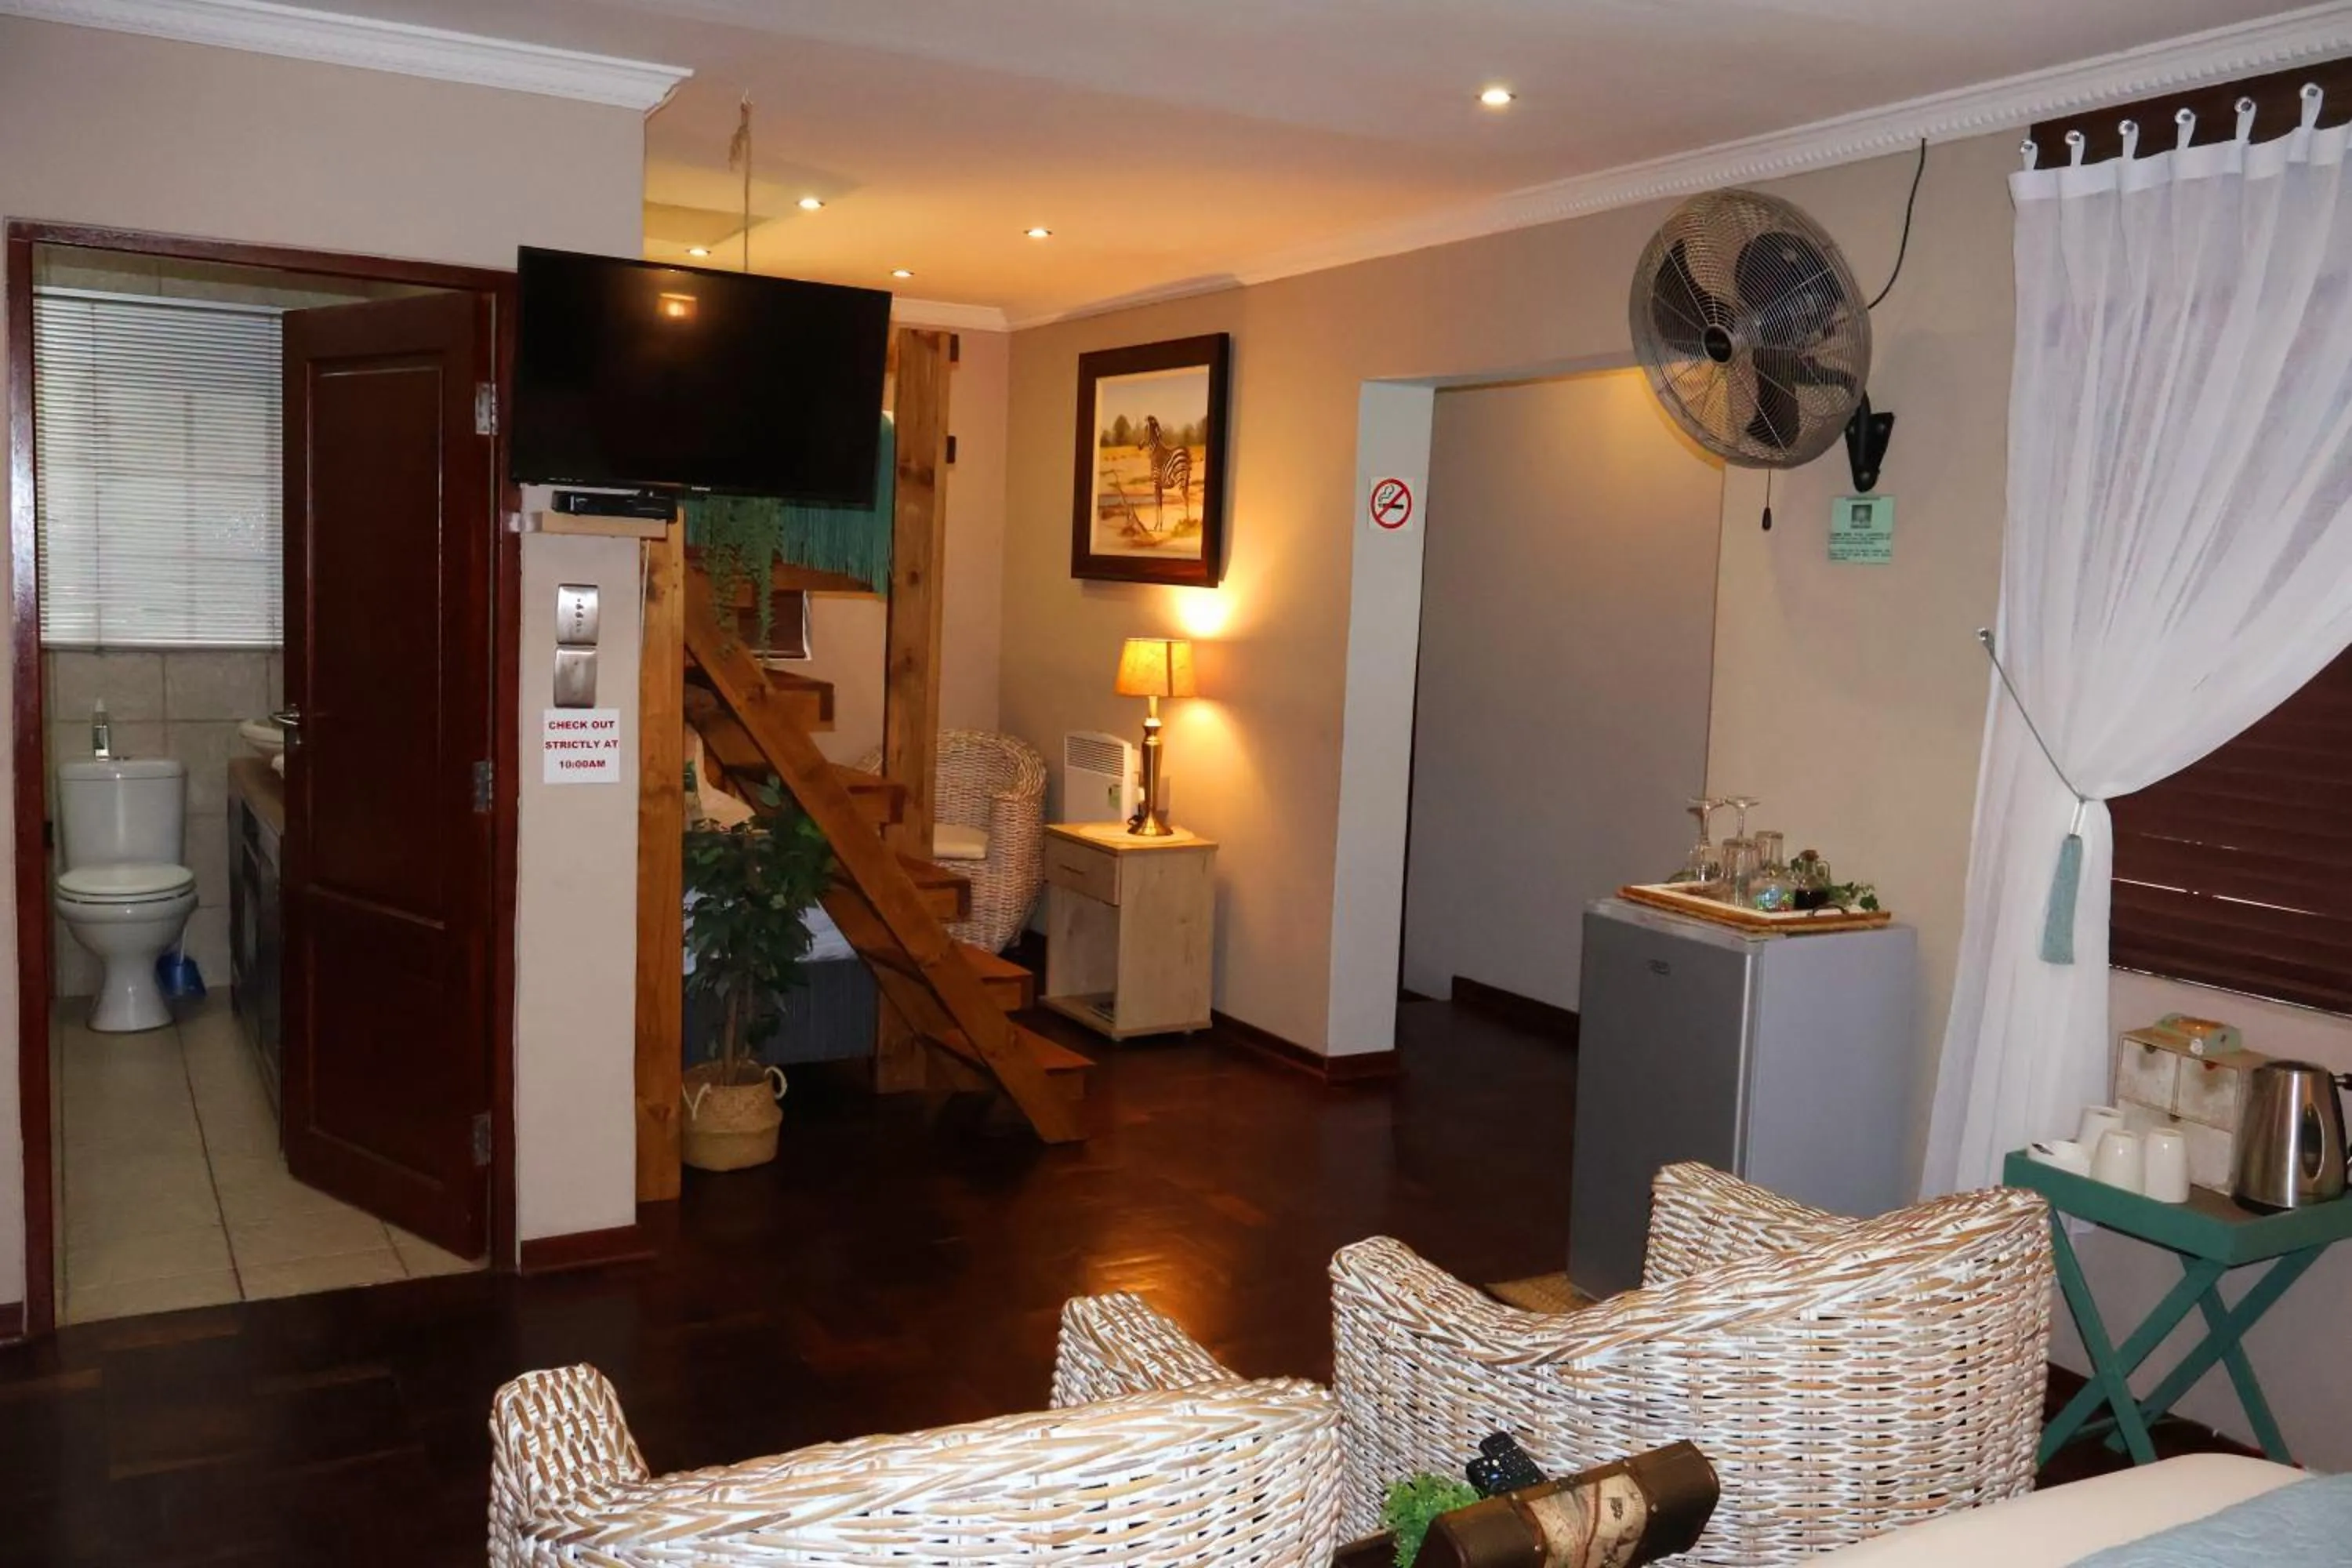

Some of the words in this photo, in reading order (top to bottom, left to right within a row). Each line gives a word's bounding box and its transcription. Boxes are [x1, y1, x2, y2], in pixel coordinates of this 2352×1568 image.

[549, 720, 587, 730] CHECK
[591, 720, 615, 729] OUT
[545, 740, 601, 750] STRICTLY
[604, 739, 619, 749] AT
[559, 759, 606, 769] 10:00AM
